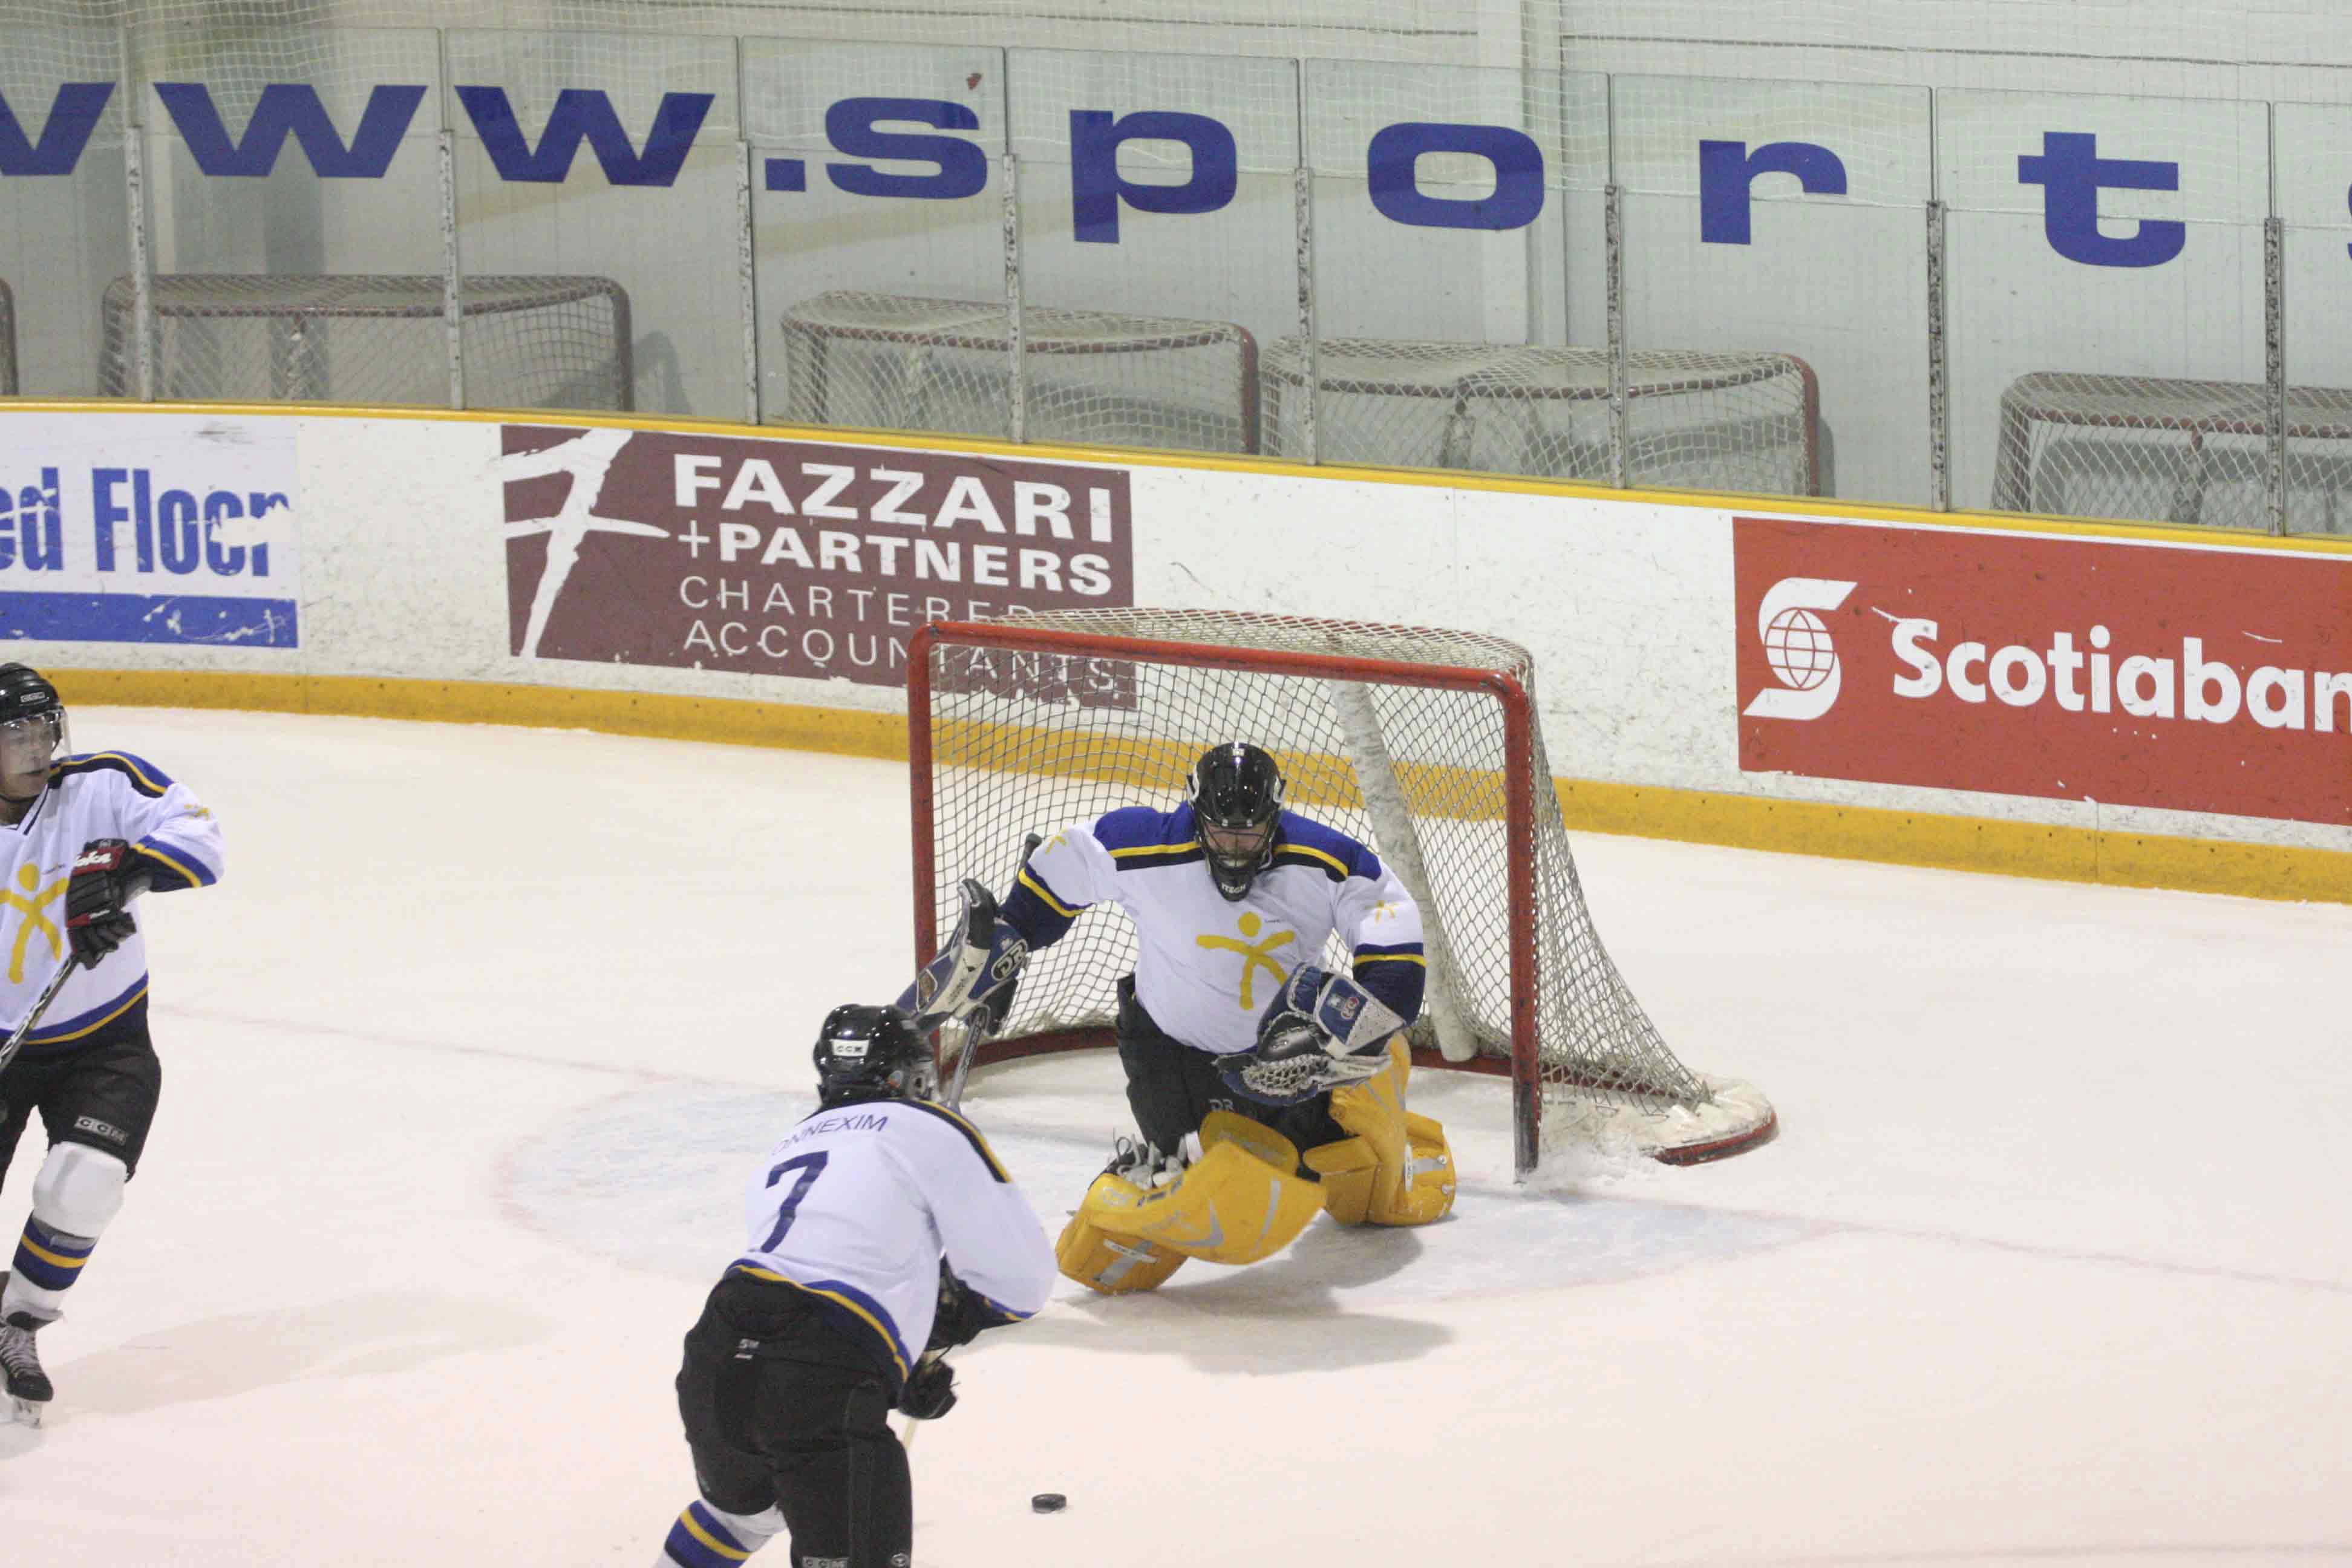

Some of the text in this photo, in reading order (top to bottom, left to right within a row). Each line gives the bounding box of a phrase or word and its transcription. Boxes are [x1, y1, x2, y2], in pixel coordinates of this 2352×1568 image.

[0, 81, 2352, 269] ww.sport
[674, 453, 1113, 543] FAZZARI
[765, 1150, 829, 1254] 7
